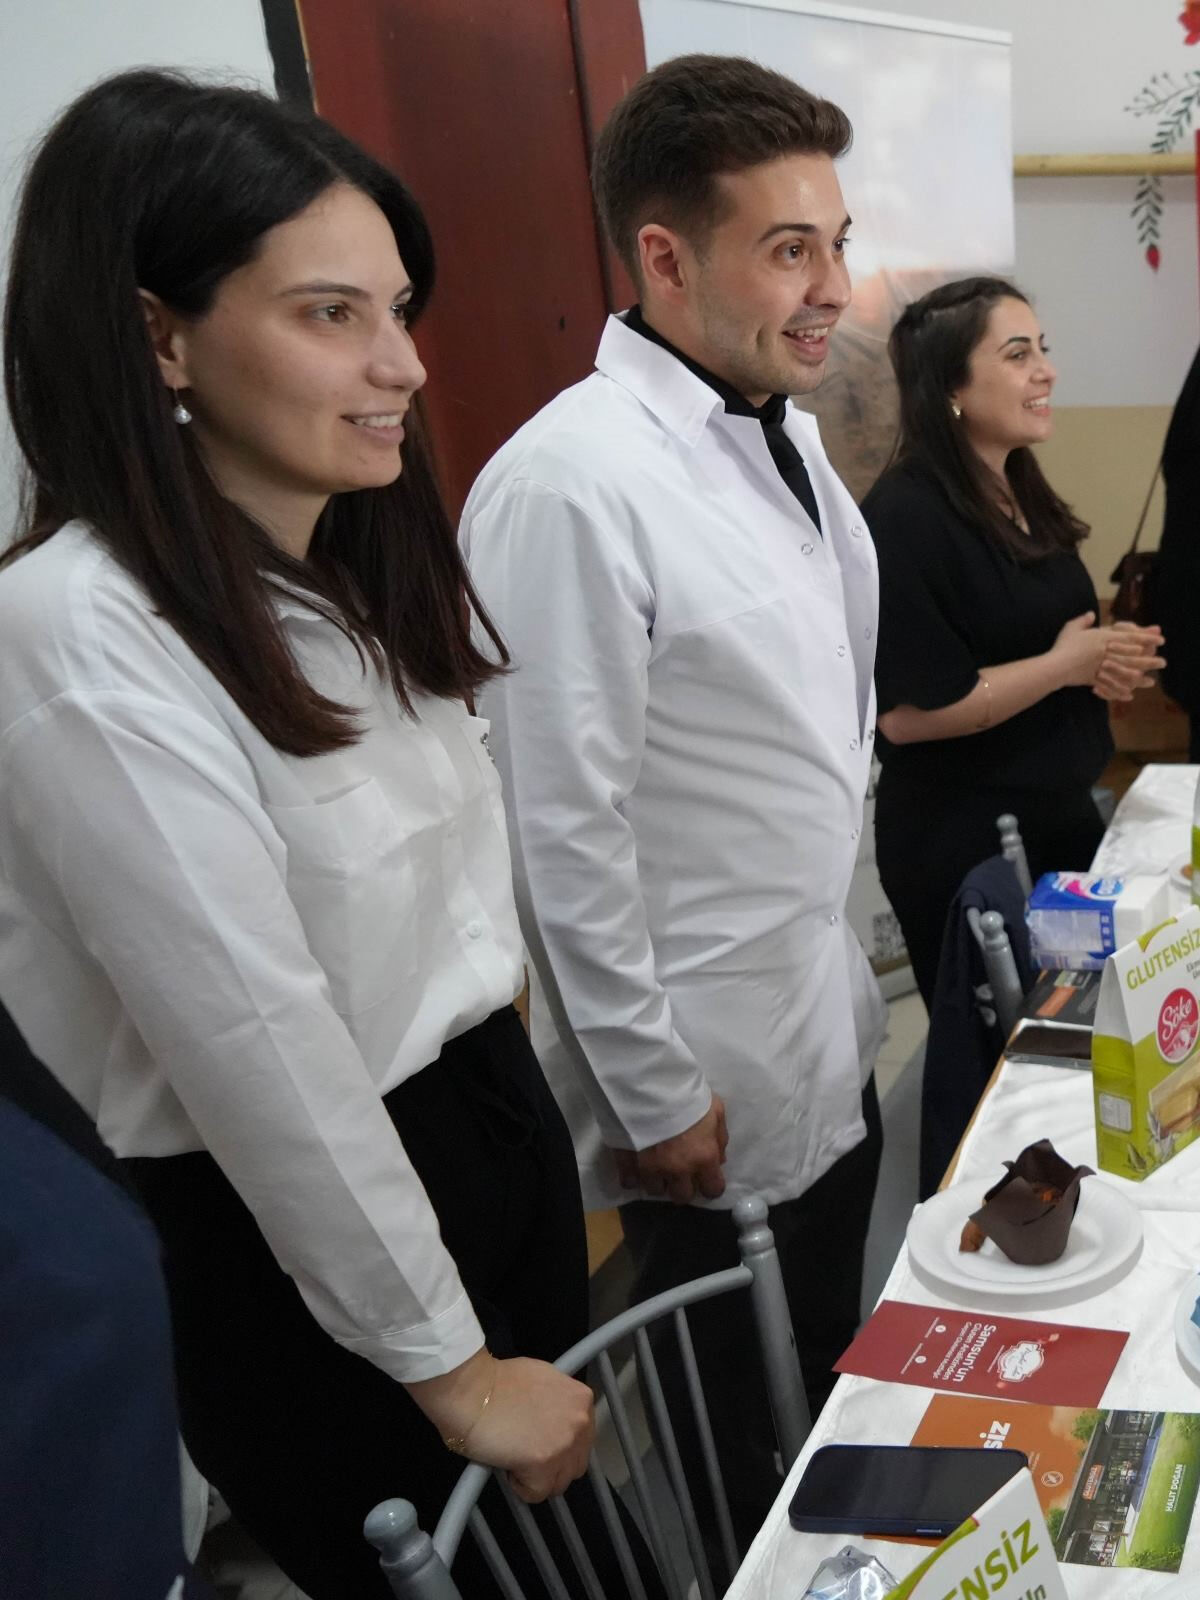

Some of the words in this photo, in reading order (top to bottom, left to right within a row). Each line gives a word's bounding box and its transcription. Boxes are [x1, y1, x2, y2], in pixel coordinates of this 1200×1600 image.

[1162, 996, 1192, 1041] Söke
[953, 1324, 996, 1383] Samsun'un
[980, 1420, 1011, 1449] siz
[942, 1518, 1039, 1600] NSİZ
